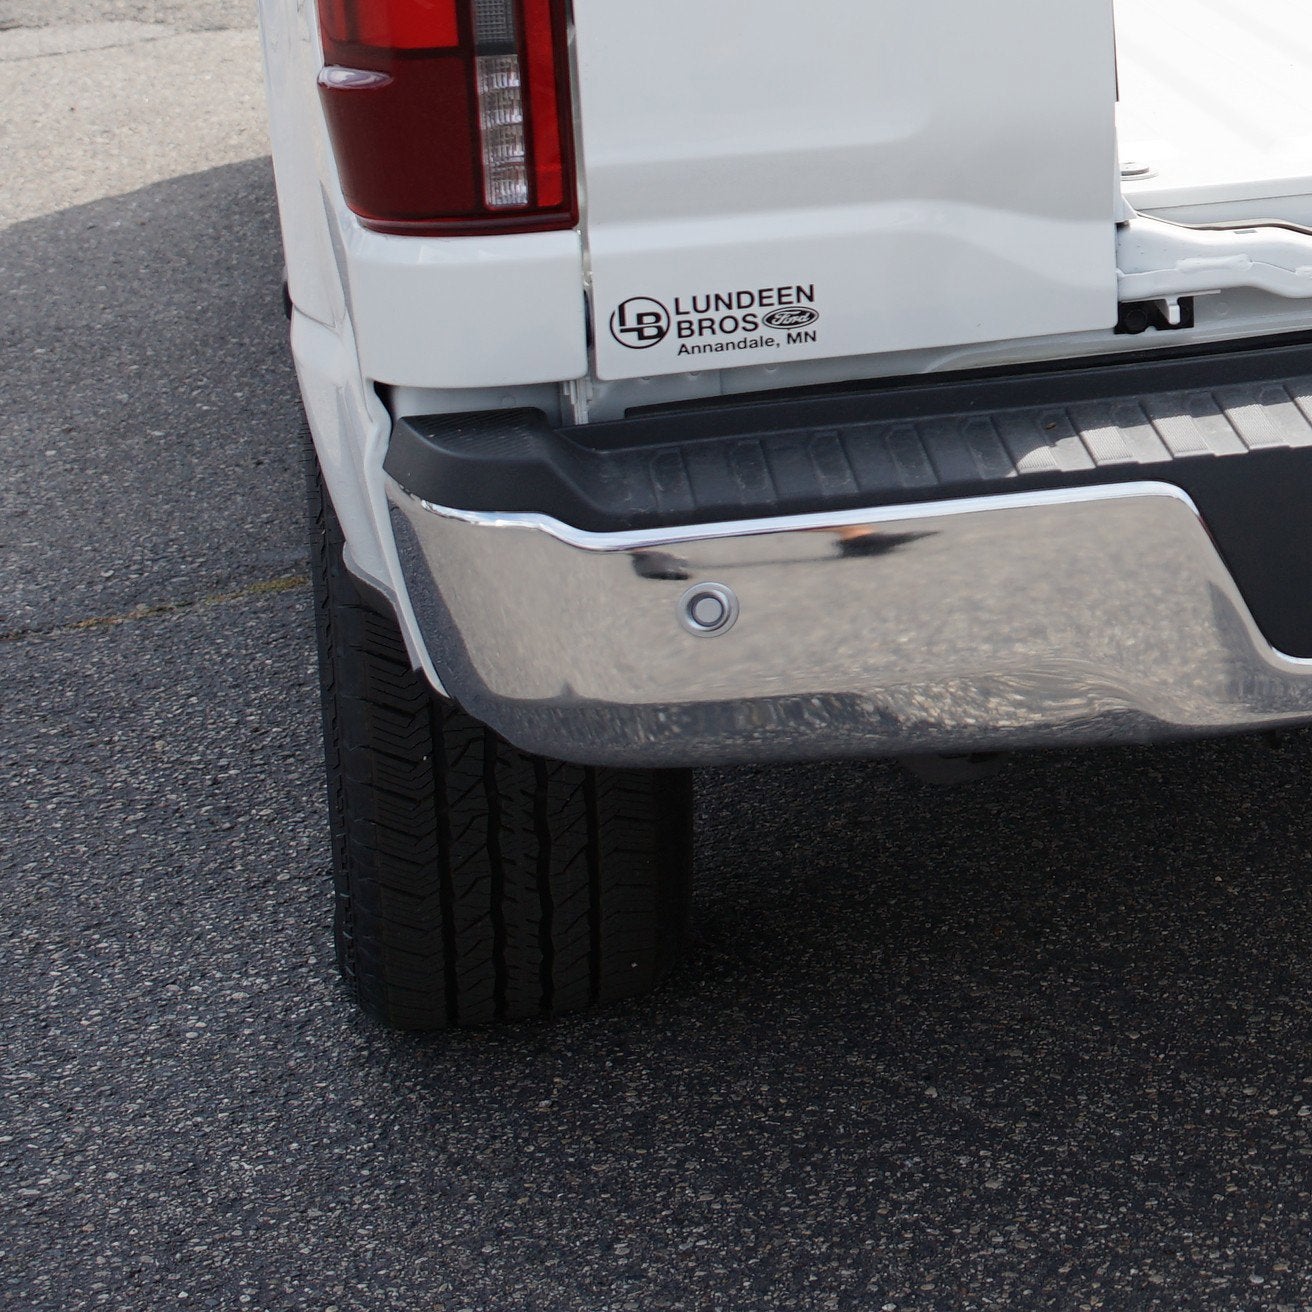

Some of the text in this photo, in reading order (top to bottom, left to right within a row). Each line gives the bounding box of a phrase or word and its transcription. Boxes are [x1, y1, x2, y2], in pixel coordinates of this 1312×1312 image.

[674, 284, 815, 316] LUNDEEN
[676, 312, 759, 339] BROS
[676, 329, 818, 357] Annandale, MN
